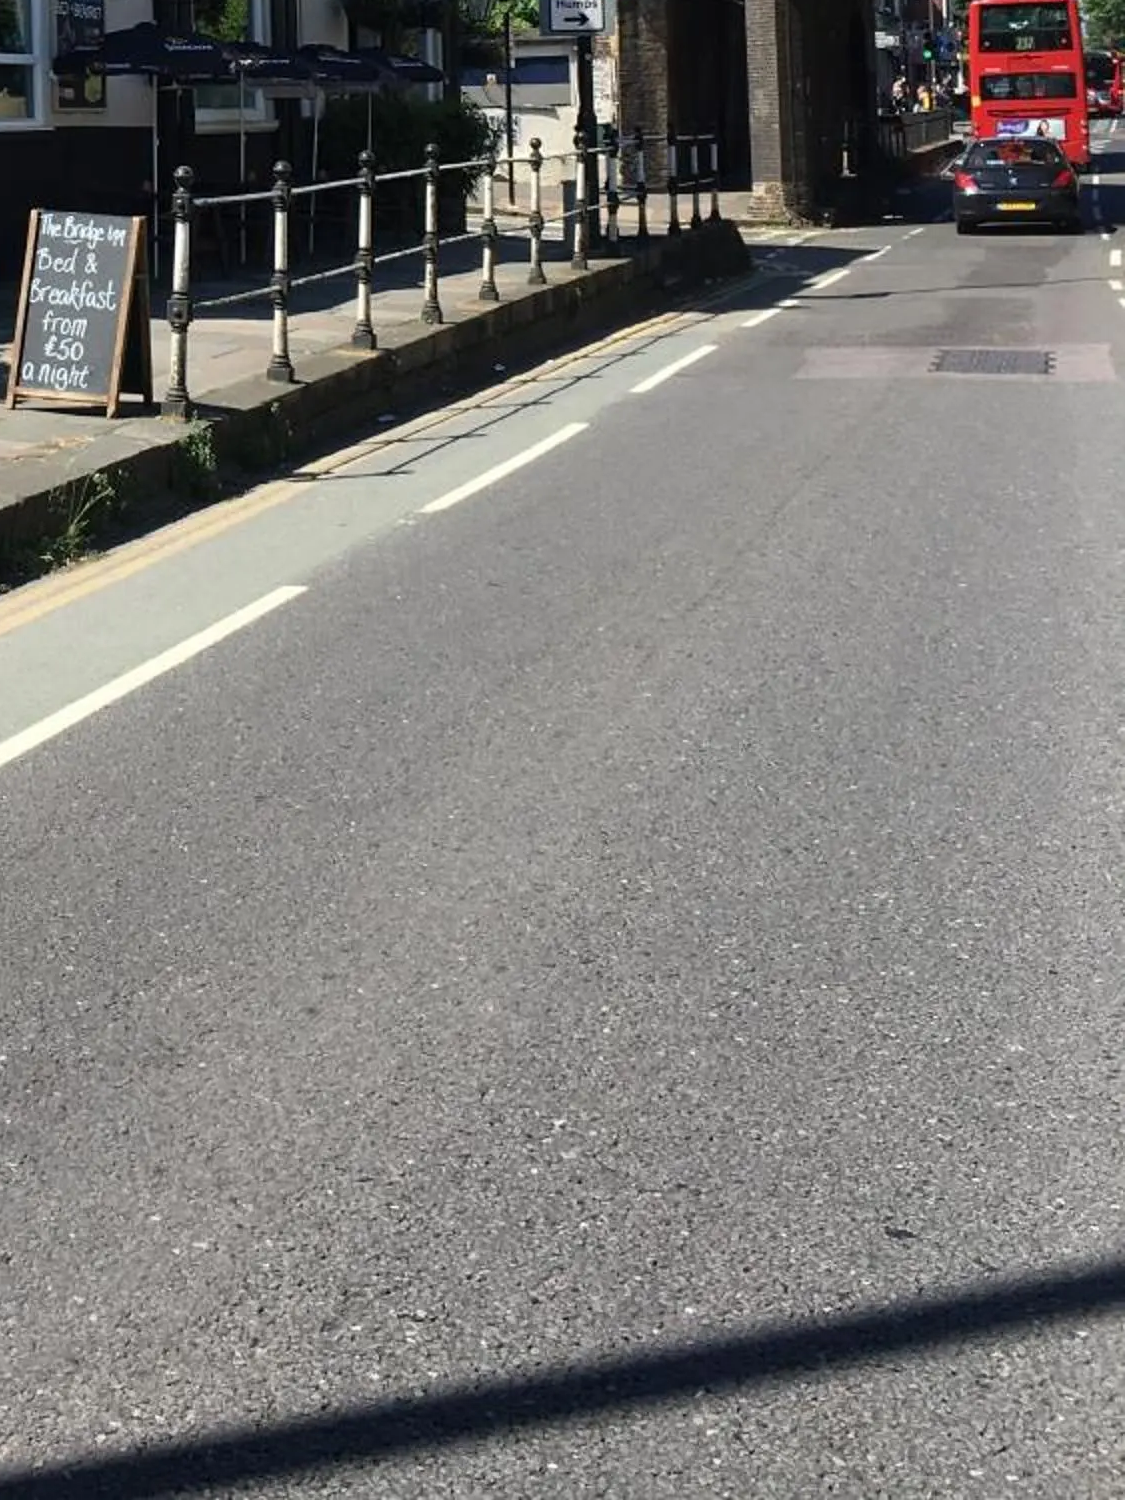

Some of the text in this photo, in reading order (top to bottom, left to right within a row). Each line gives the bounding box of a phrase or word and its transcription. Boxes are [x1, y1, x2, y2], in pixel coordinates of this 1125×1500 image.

[40, 214, 62, 237] The
[63, 216, 105, 248] Bridge
[37, 247, 98, 274] Bed &
[30, 278, 116, 311] Breakfast
[43, 311, 88, 337] from
[44, 335, 84, 361] £50
[22, 363, 89, 390] a night
